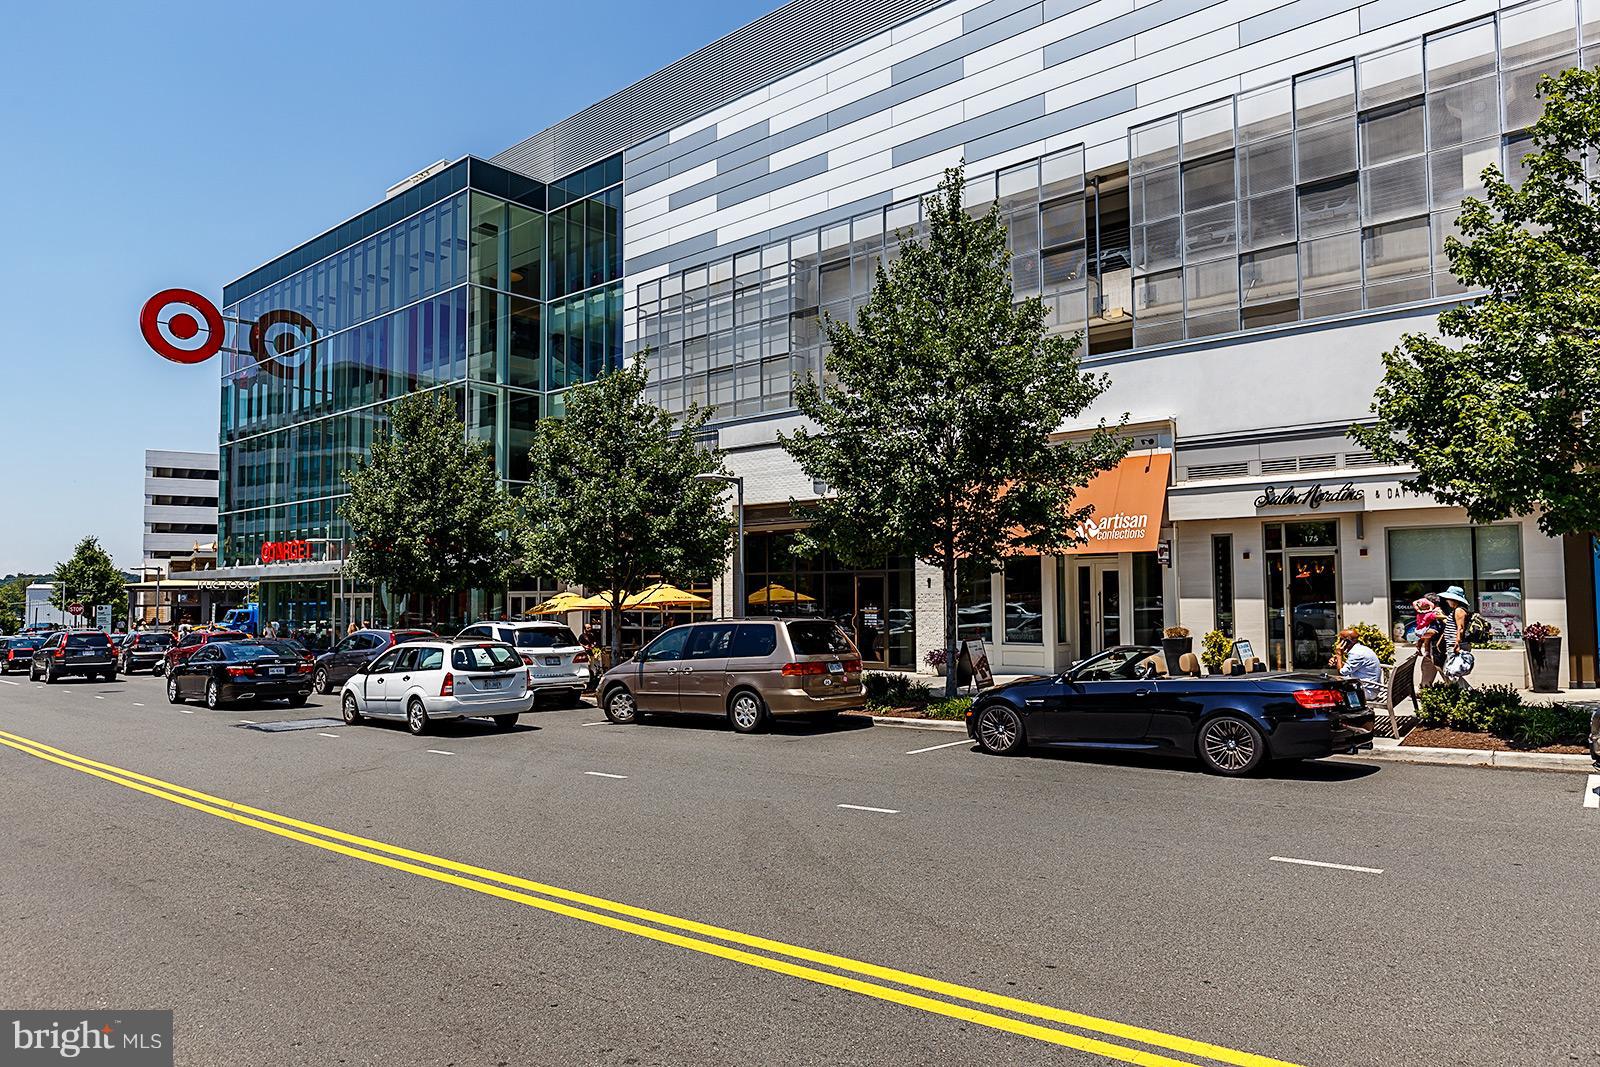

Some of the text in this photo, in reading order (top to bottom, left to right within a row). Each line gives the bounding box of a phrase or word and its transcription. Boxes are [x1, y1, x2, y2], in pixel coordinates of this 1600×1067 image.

[1254, 486, 1300, 508] Salon
[1099, 513, 1147, 530] artisan
[1097, 529, 1145, 540] confections
[1305, 535, 1319, 543] 175
[274, 540, 312, 561] TARGET
